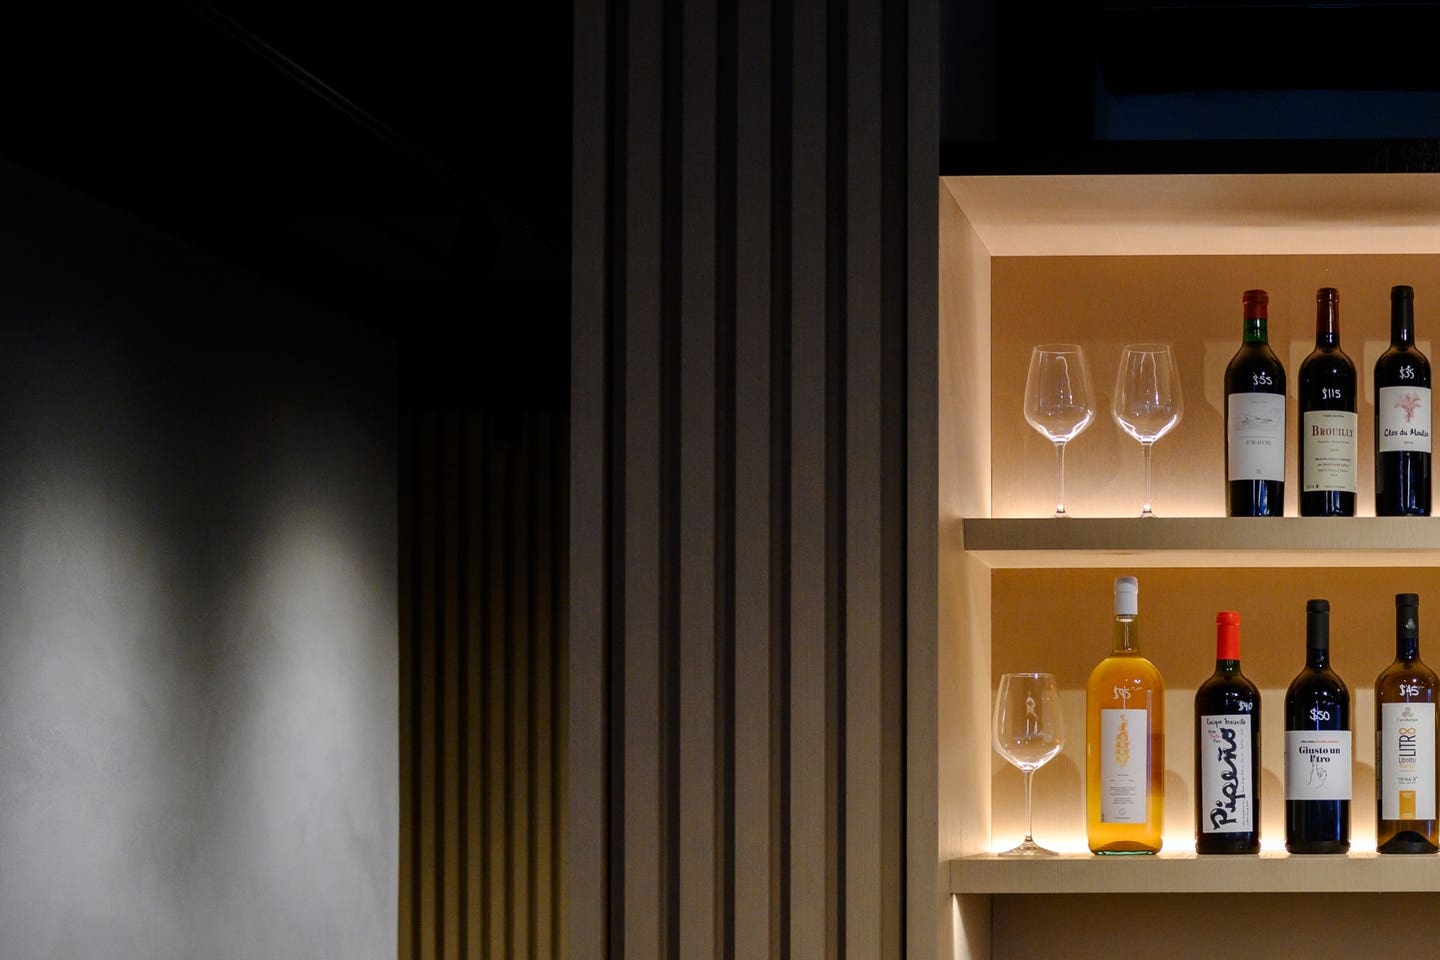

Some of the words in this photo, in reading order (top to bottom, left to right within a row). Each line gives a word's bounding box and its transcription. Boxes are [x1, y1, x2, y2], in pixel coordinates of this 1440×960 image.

[1322, 387, 1341, 399] $115
[1312, 425, 1353, 437] BROUILLY
[1384, 428, 1398, 437] Clos
[1399, 428, 1408, 436] du
[1399, 684, 1419, 696] $45
[1309, 707, 1330, 721] $50
[1299, 746, 1329, 754] Giusto
[1209, 728, 1246, 831] Pipeño
